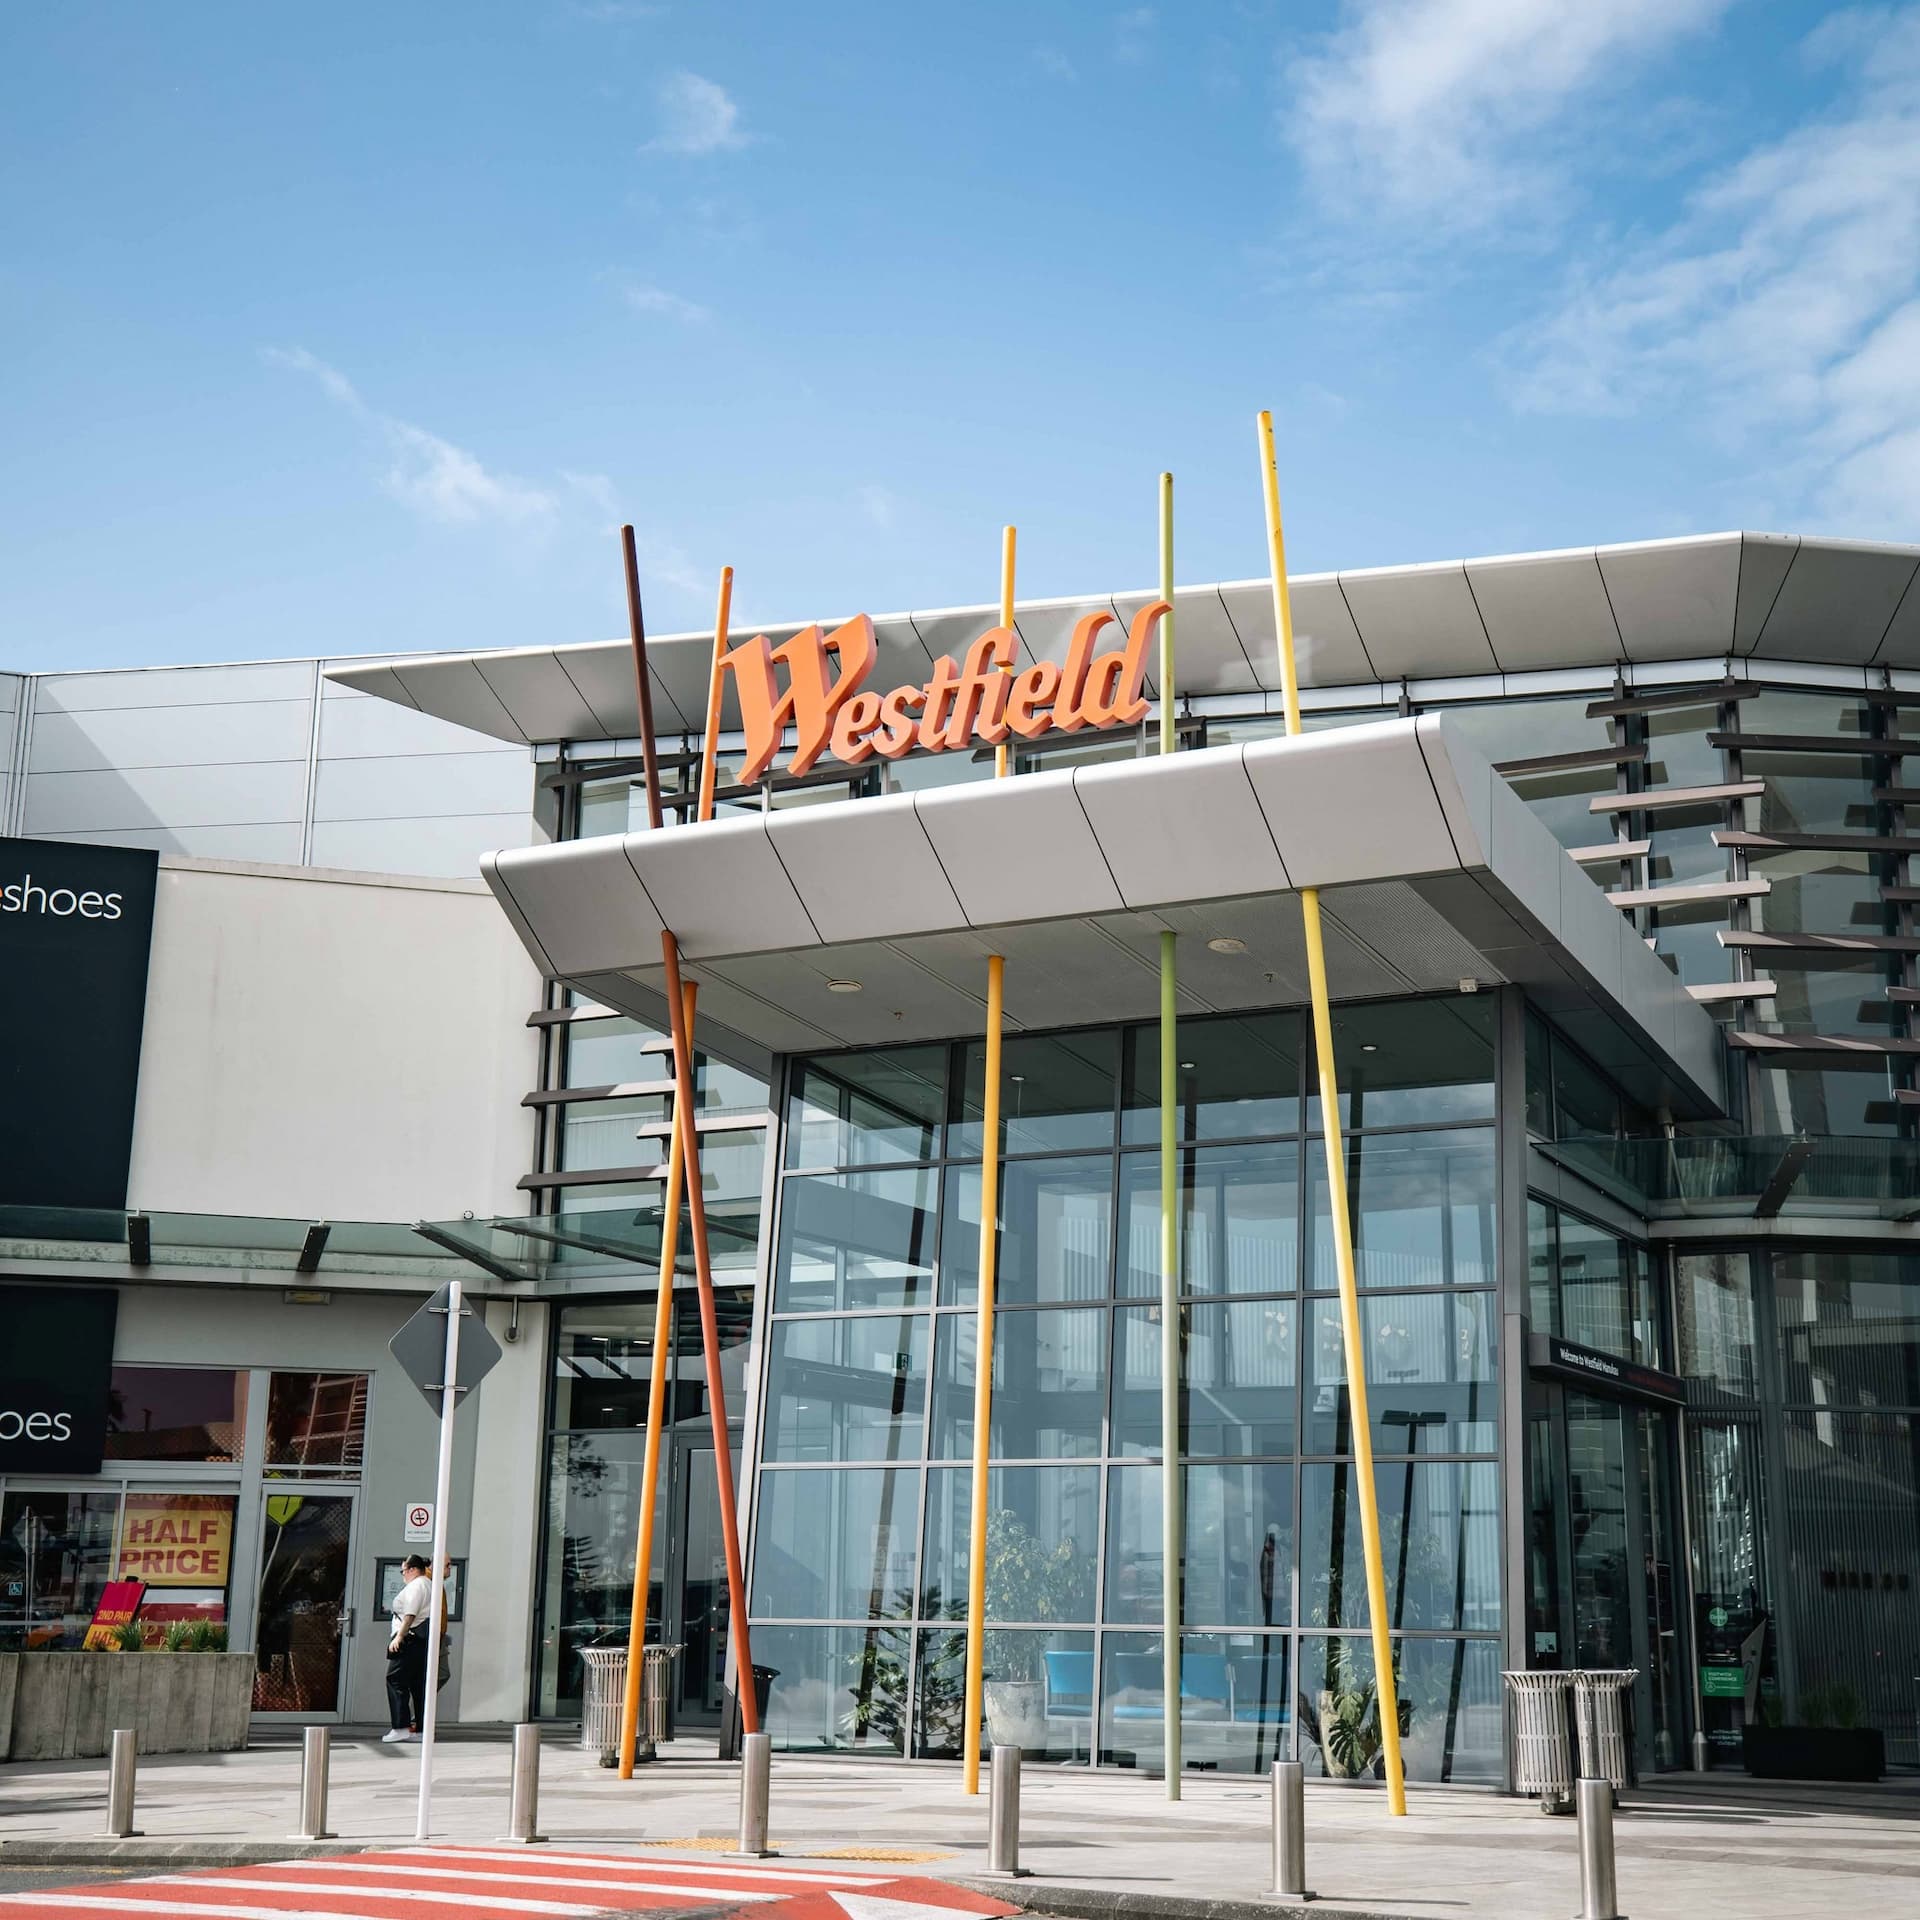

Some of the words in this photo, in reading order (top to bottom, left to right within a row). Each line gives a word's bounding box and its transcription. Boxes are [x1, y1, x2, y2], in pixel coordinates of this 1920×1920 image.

[717, 600, 1173, 786] Westfield
[0, 874, 122, 920] shoes
[129, 1520, 219, 1544] HALF
[119, 1549, 221, 1574] PRICE
[97, 1609, 114, 1620] 2ND
[113, 1610, 133, 1622] PAIR
[90, 1630, 117, 1647] HAL
